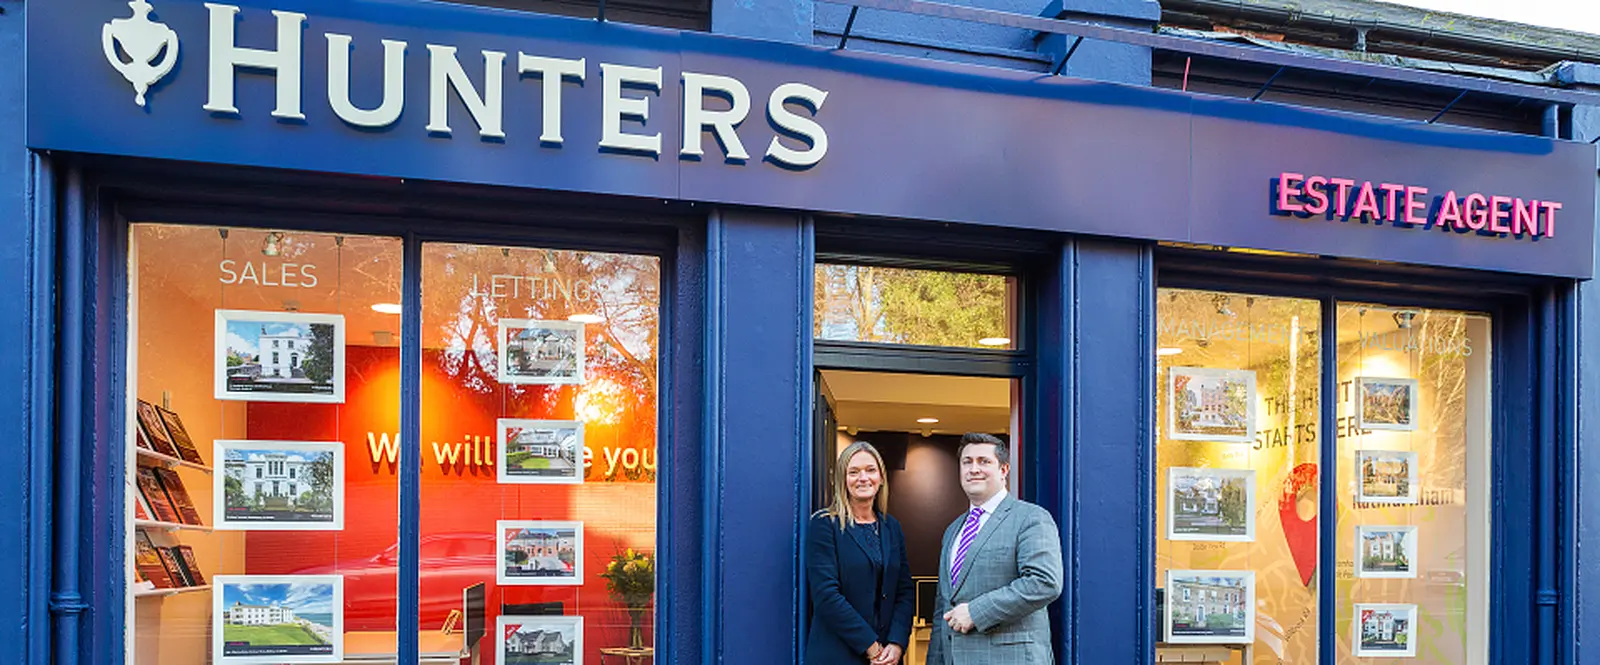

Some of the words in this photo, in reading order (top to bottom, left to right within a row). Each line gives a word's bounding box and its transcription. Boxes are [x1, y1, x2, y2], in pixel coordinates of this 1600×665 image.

[203, 2, 829, 166] HUNTERS
[1279, 172, 1428, 225] ESTATE
[1436, 190, 1562, 238] AGENT
[219, 259, 318, 288] SALES
[472, 273, 597, 302] LETTING
[1358, 330, 1473, 356] VALUAIONS
[432, 435, 493, 467] will
